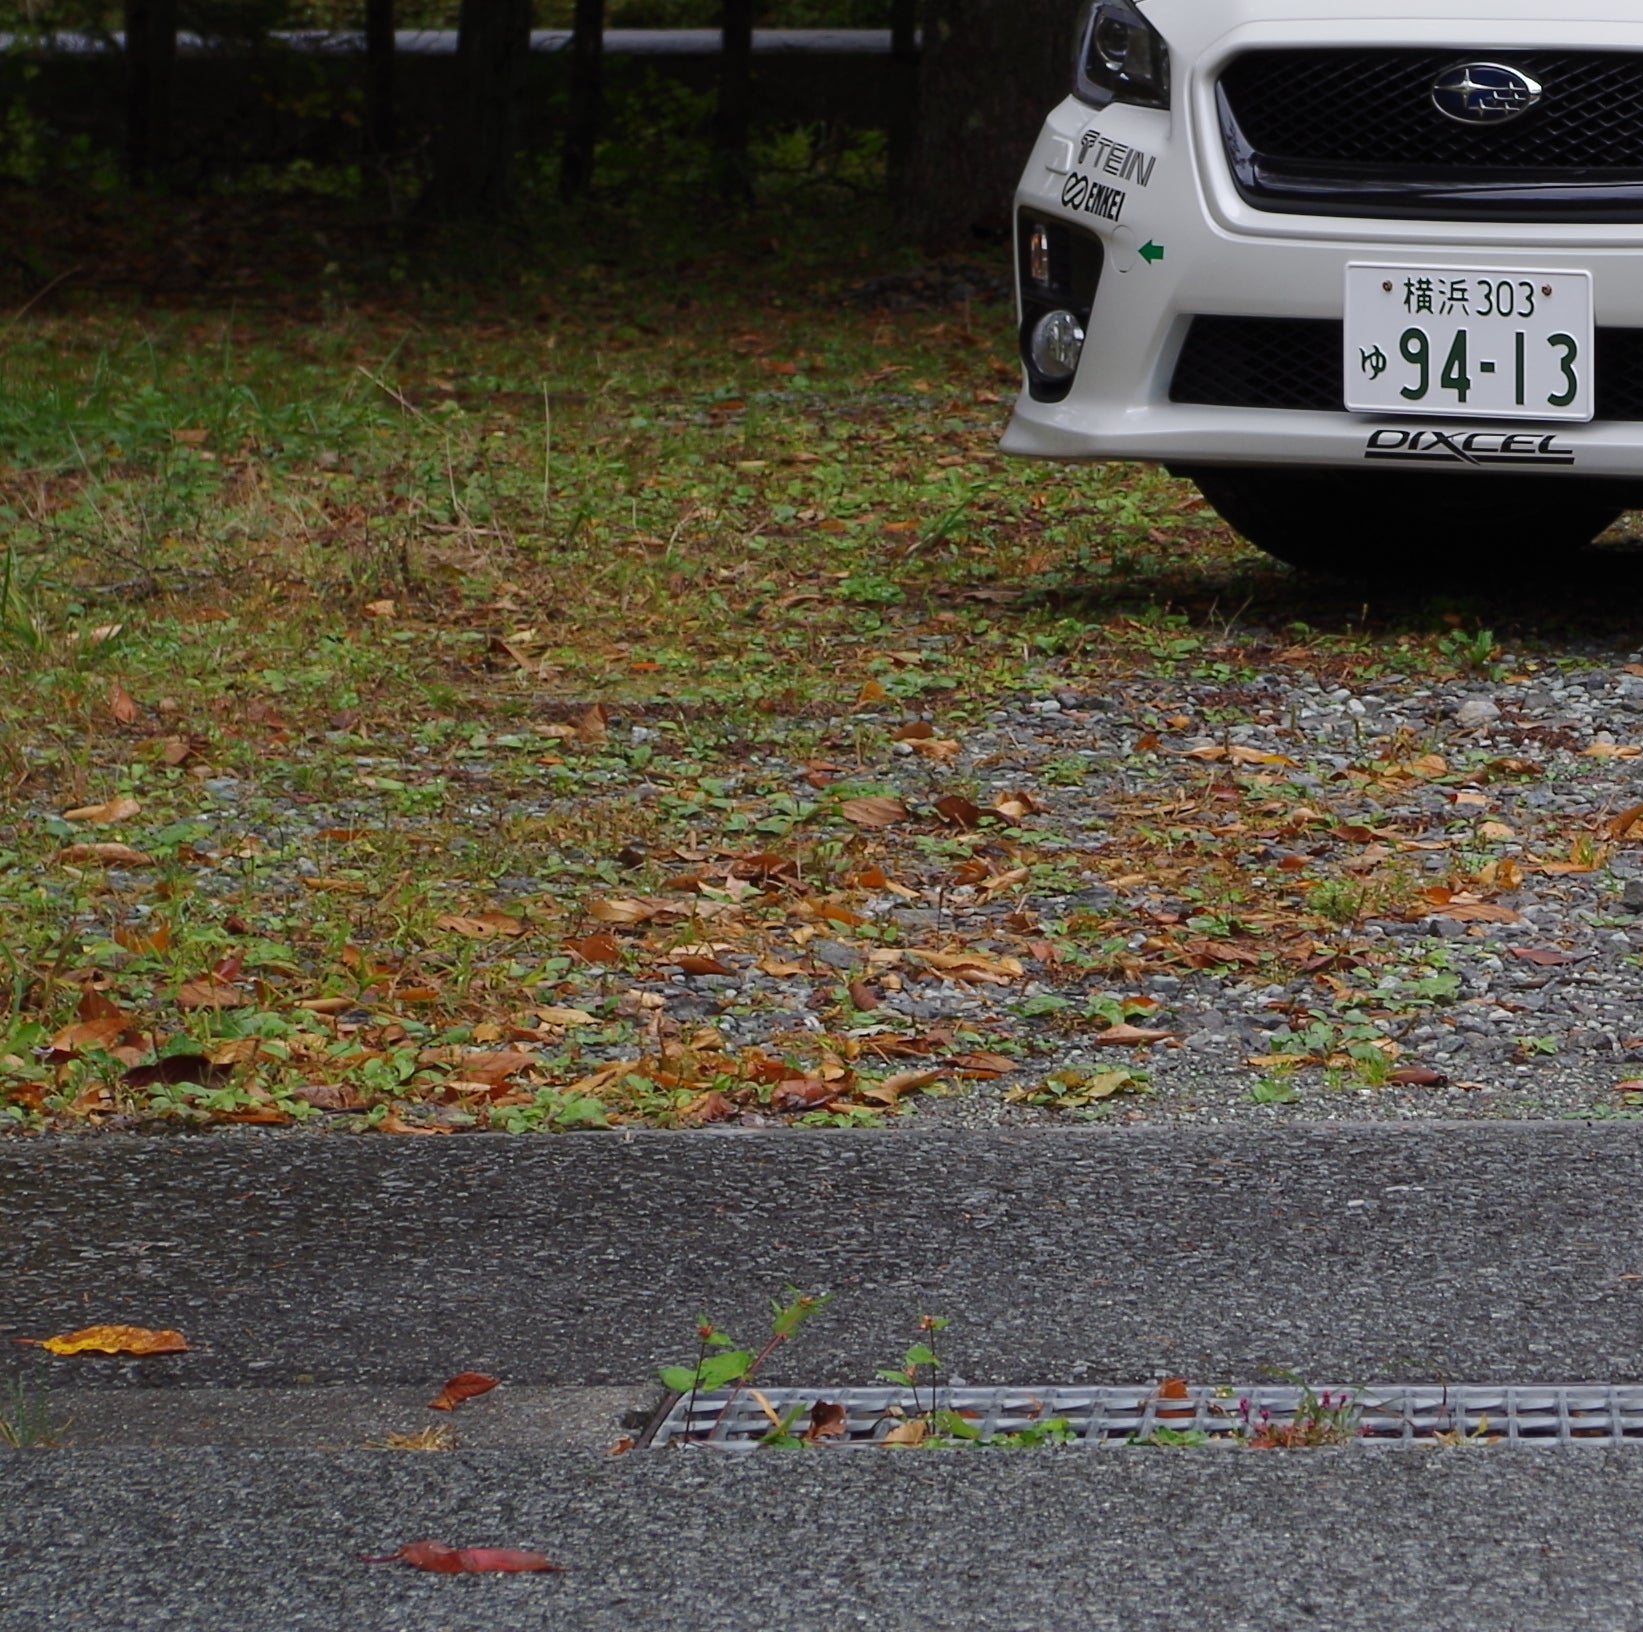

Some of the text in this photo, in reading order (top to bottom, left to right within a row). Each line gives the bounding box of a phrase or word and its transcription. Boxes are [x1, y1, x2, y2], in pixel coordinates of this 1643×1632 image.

[1094, 137, 1157, 188] TEIN
[1084, 181, 1127, 223] ENKEI
[1399, 326, 1578, 407] 94-13
[1364, 429, 1575, 466] DIXCEL
